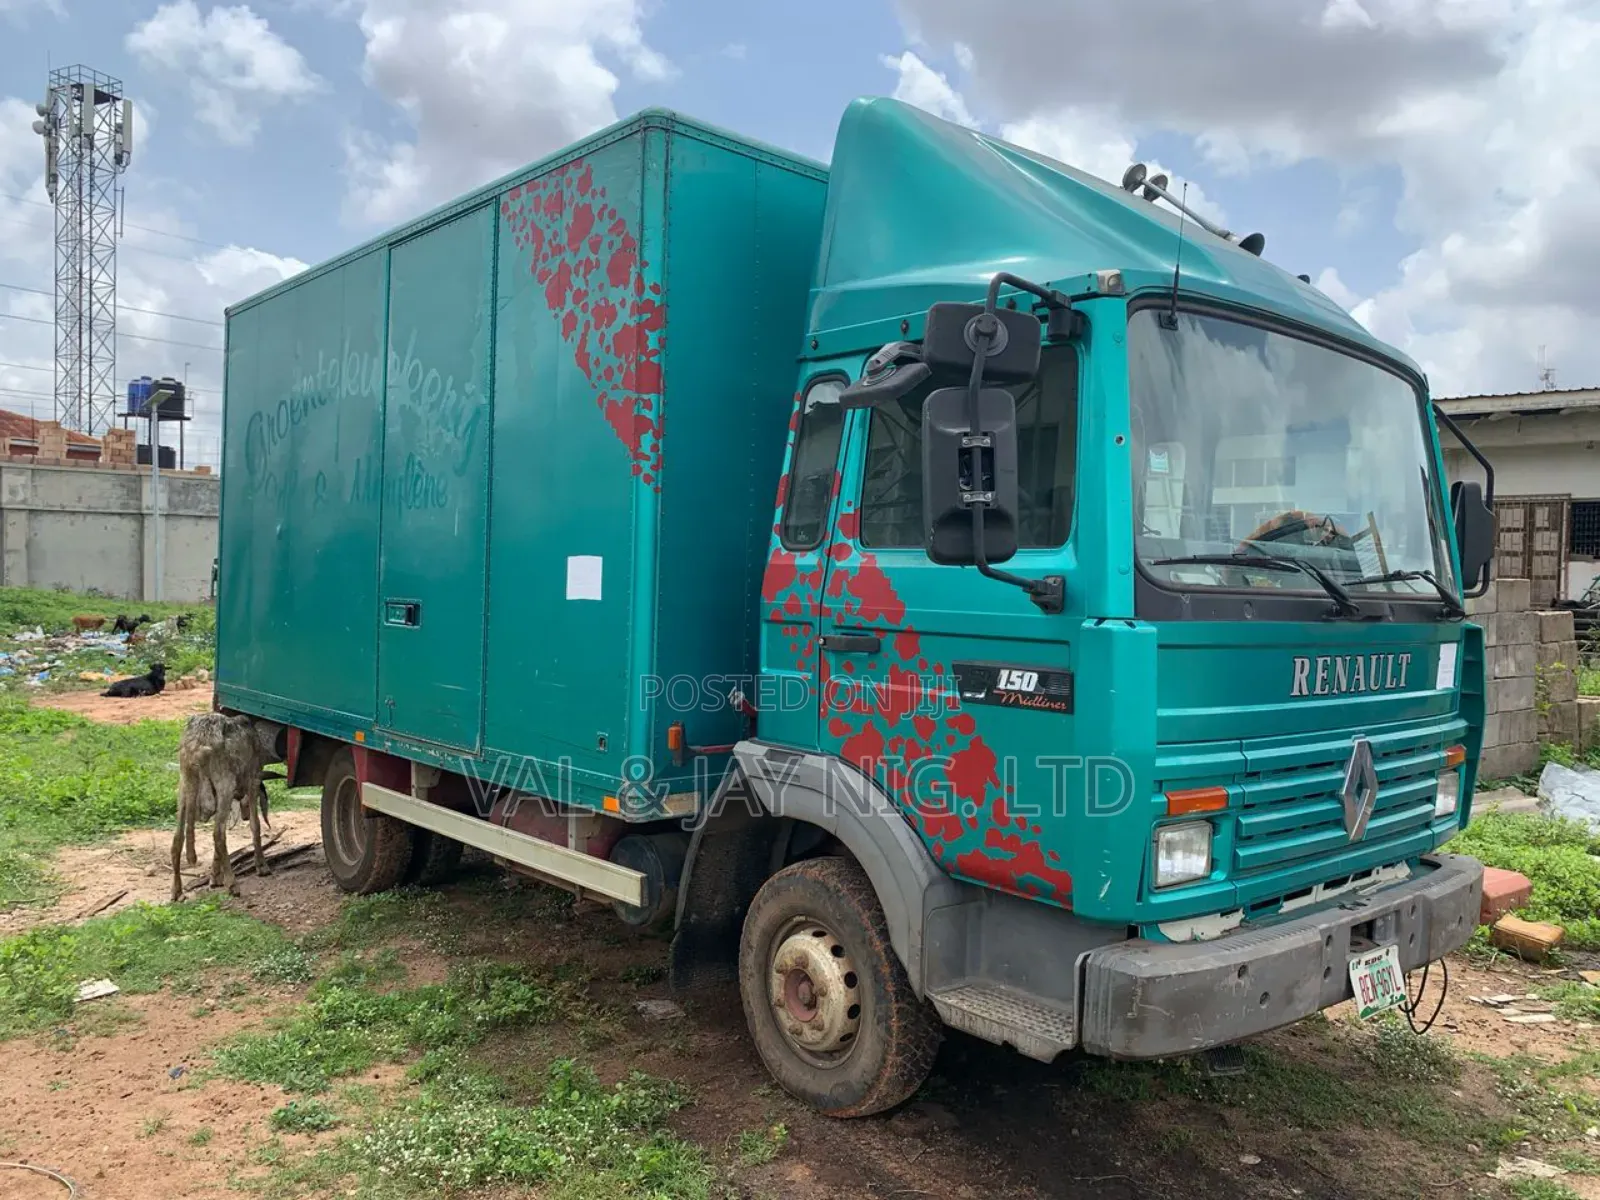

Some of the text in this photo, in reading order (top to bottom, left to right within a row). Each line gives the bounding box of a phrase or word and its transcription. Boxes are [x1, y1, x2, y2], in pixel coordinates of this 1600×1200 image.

[995, 669, 1039, 692] 150
[1289, 653, 1412, 697] RENAULT
[995, 690, 1067, 710] Midliner
